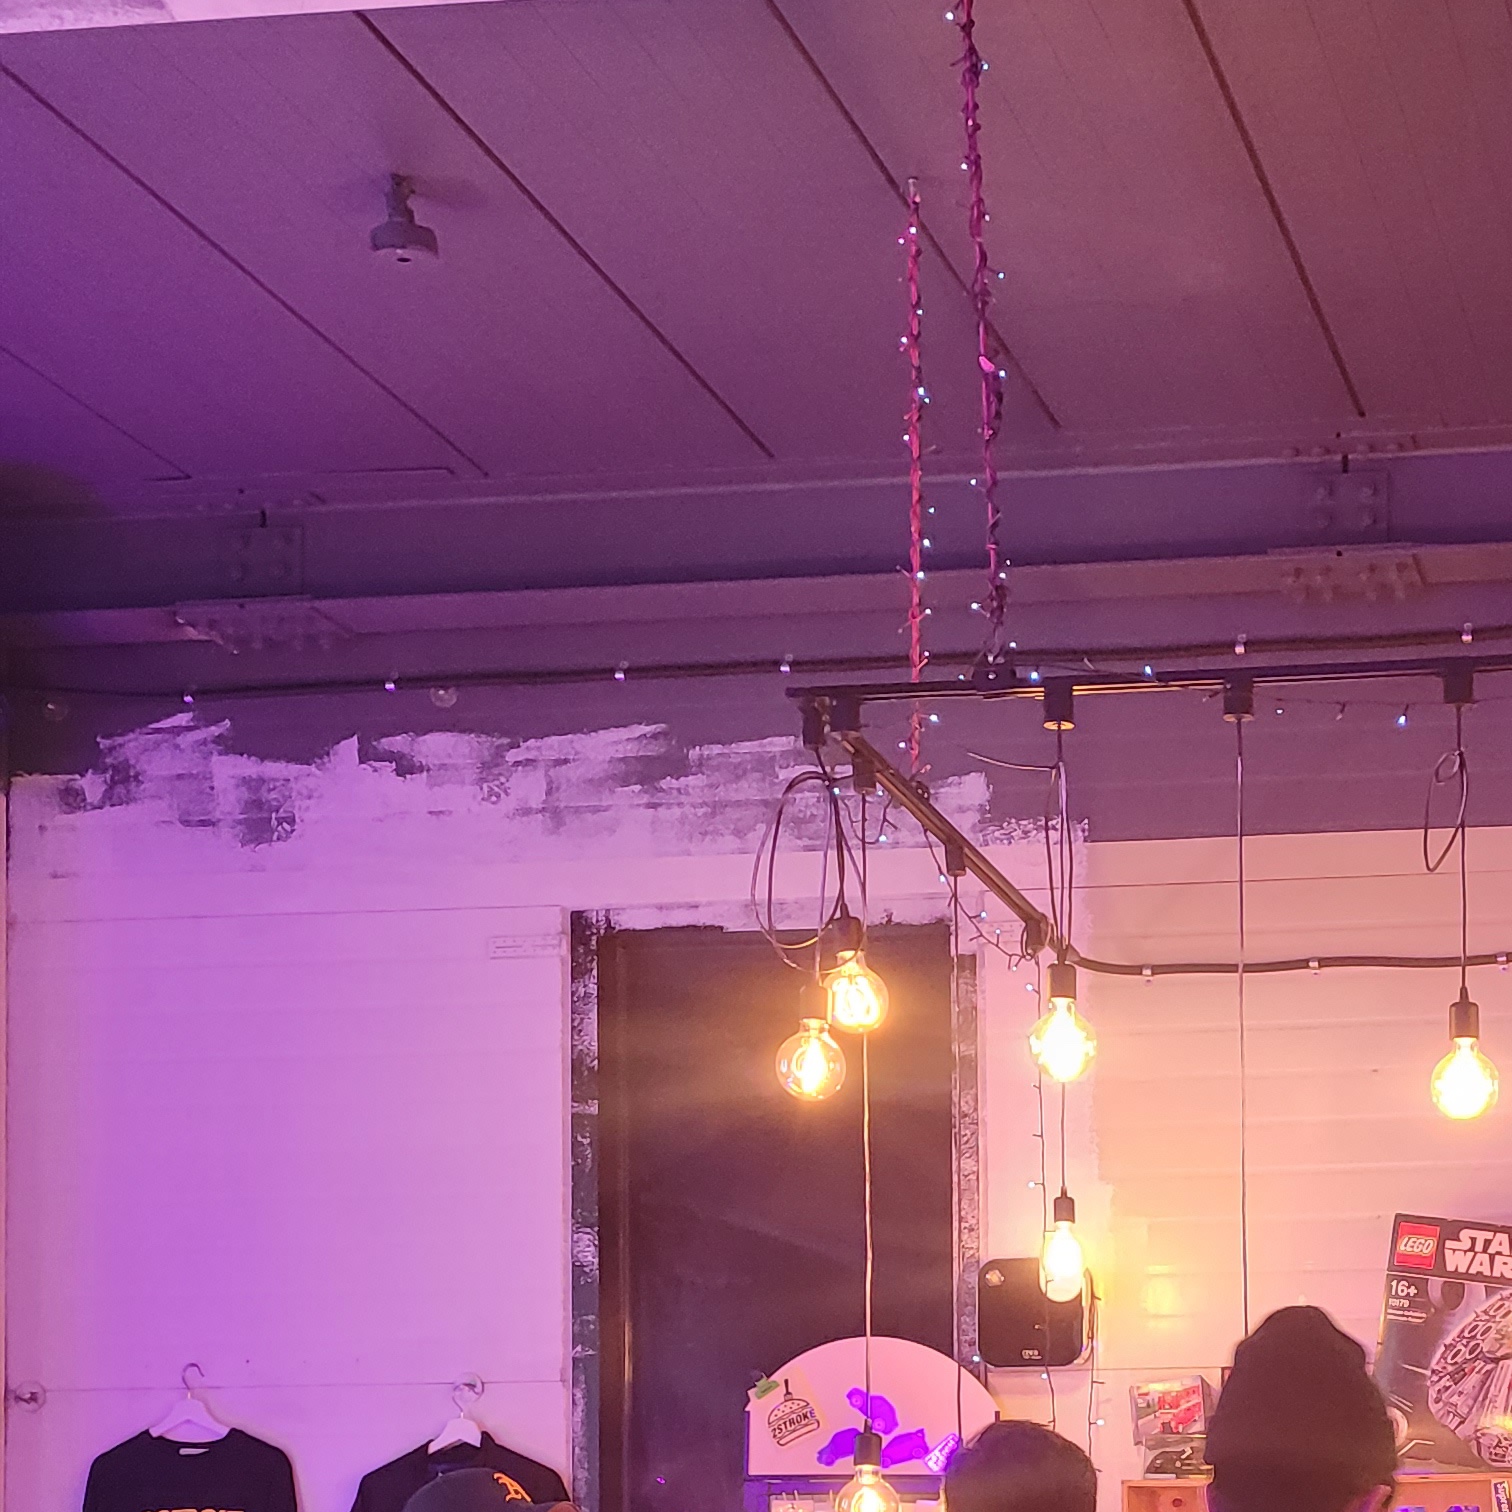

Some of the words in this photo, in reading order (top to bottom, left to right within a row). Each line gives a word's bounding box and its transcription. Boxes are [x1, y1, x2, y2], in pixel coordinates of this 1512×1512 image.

[1399, 1236, 1434, 1254] LEGO
[1390, 1279, 1417, 1297] 16+
[771, 1408, 817, 1439] 2STROKE
